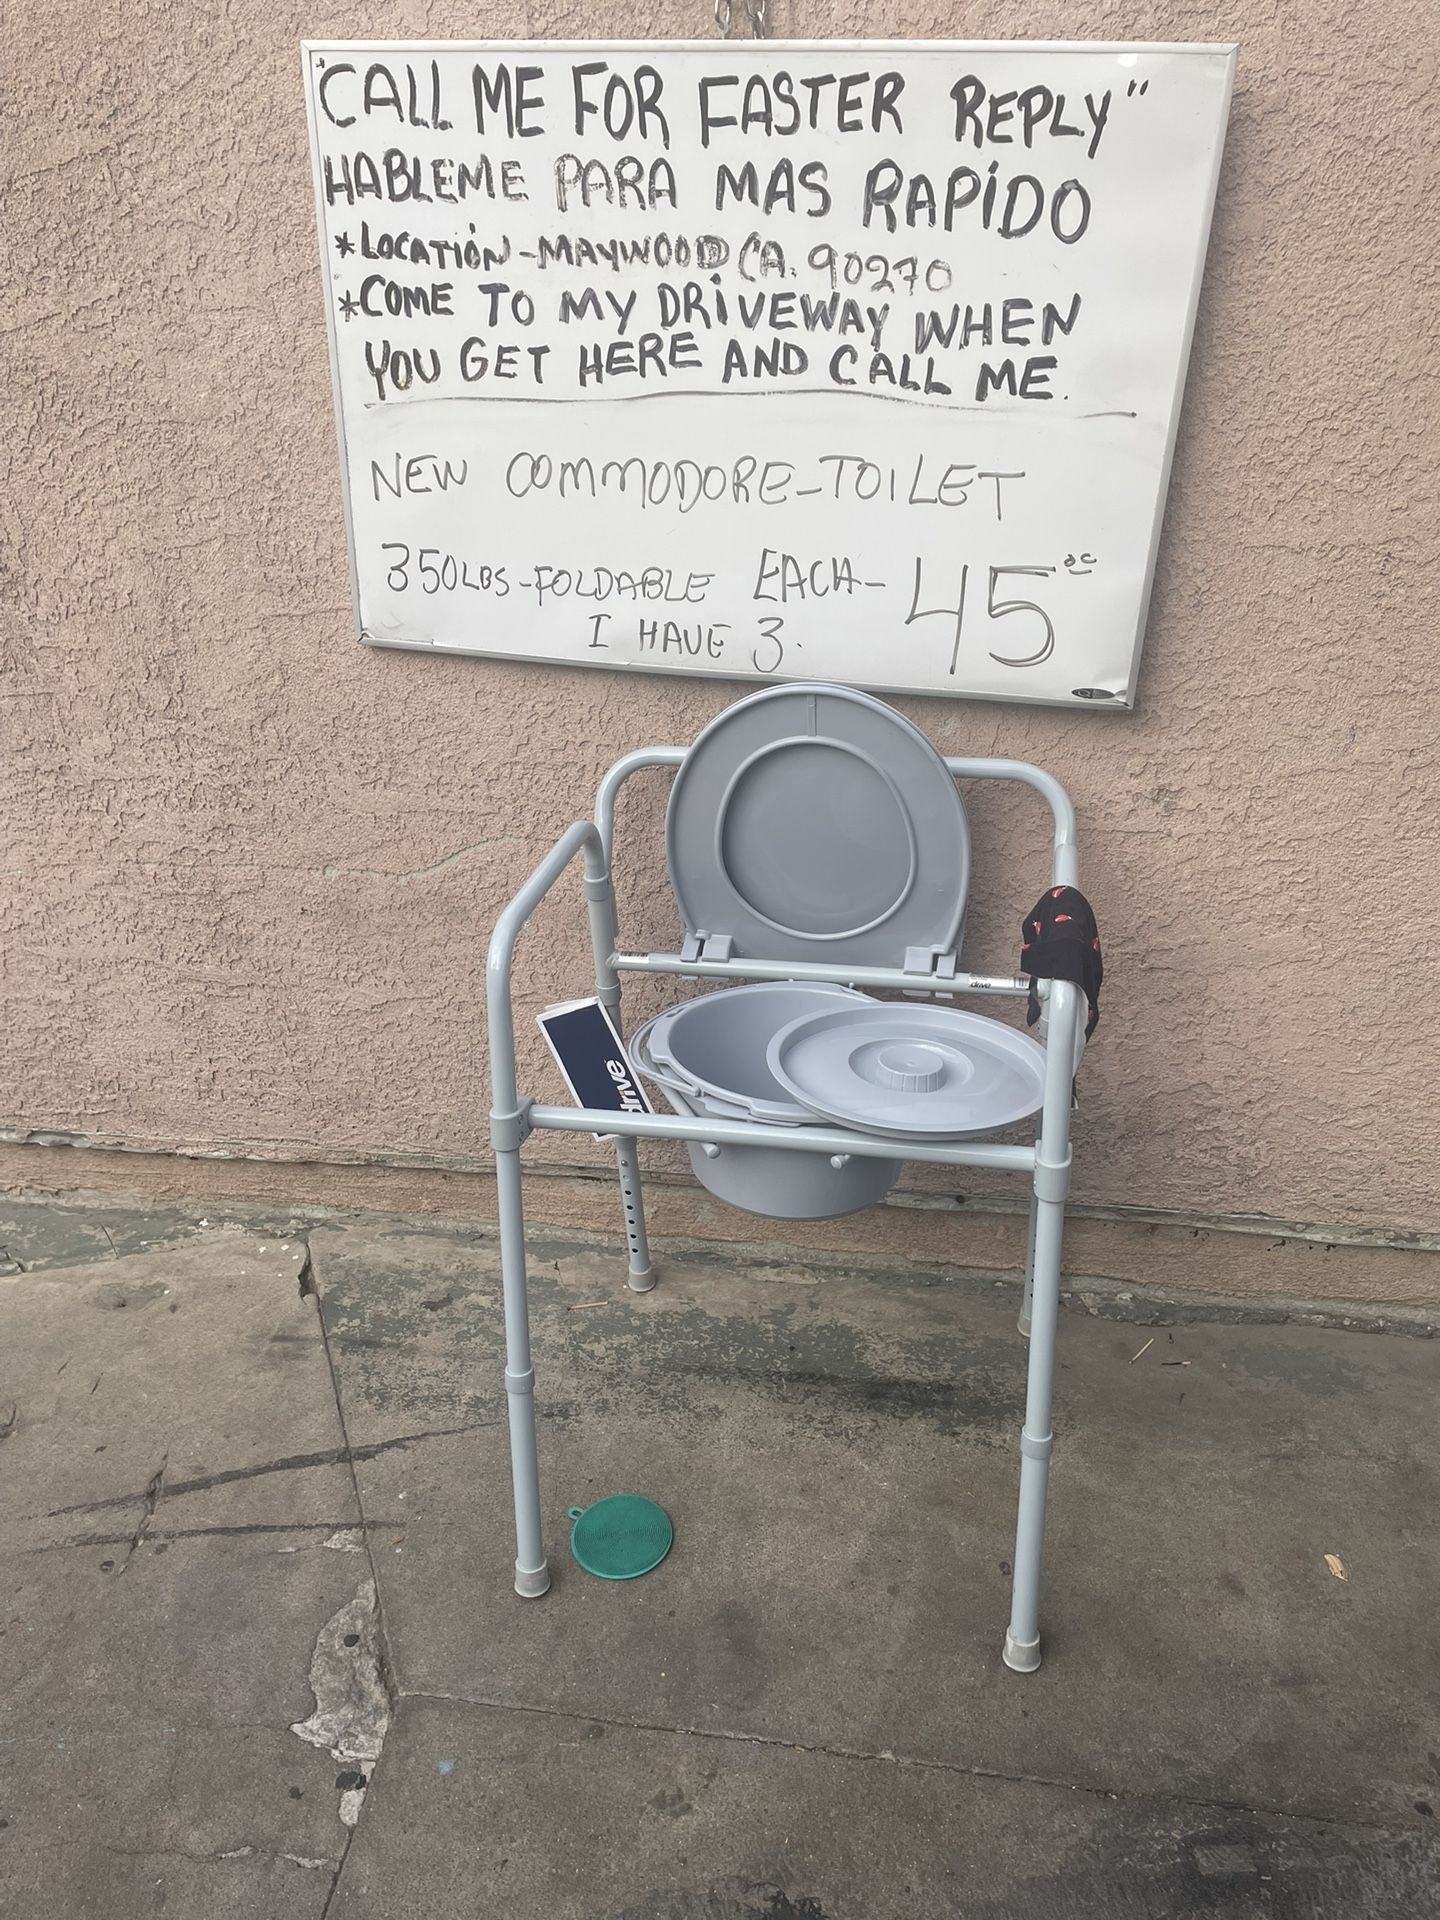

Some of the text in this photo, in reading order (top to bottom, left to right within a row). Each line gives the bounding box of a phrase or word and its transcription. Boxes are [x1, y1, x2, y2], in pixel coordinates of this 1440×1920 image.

[471, 62, 546, 140] ME
[571, 61, 671, 151] FOR
[697, 70, 906, 150] FASTER
[323, 147, 530, 207] HABLEME
[553, 152, 678, 214] PARA
[715, 156, 832, 218] MAS
[806, 243, 953, 296] 90270
[358, 273, 1082, 356] COME TO MY DRIVEWAY WHEN
[364, 339, 443, 402] YOU
[459, 336, 552, 385] GET
[578, 329, 704, 388] HERE
[721, 336, 809, 385] AND
[827, 339, 953, 397] CALL
[371, 451, 468, 502] NEW
[587, 613, 612, 648] I
[639, 618, 732, 659] HAVE
[904, 556, 1057, 676] 45
